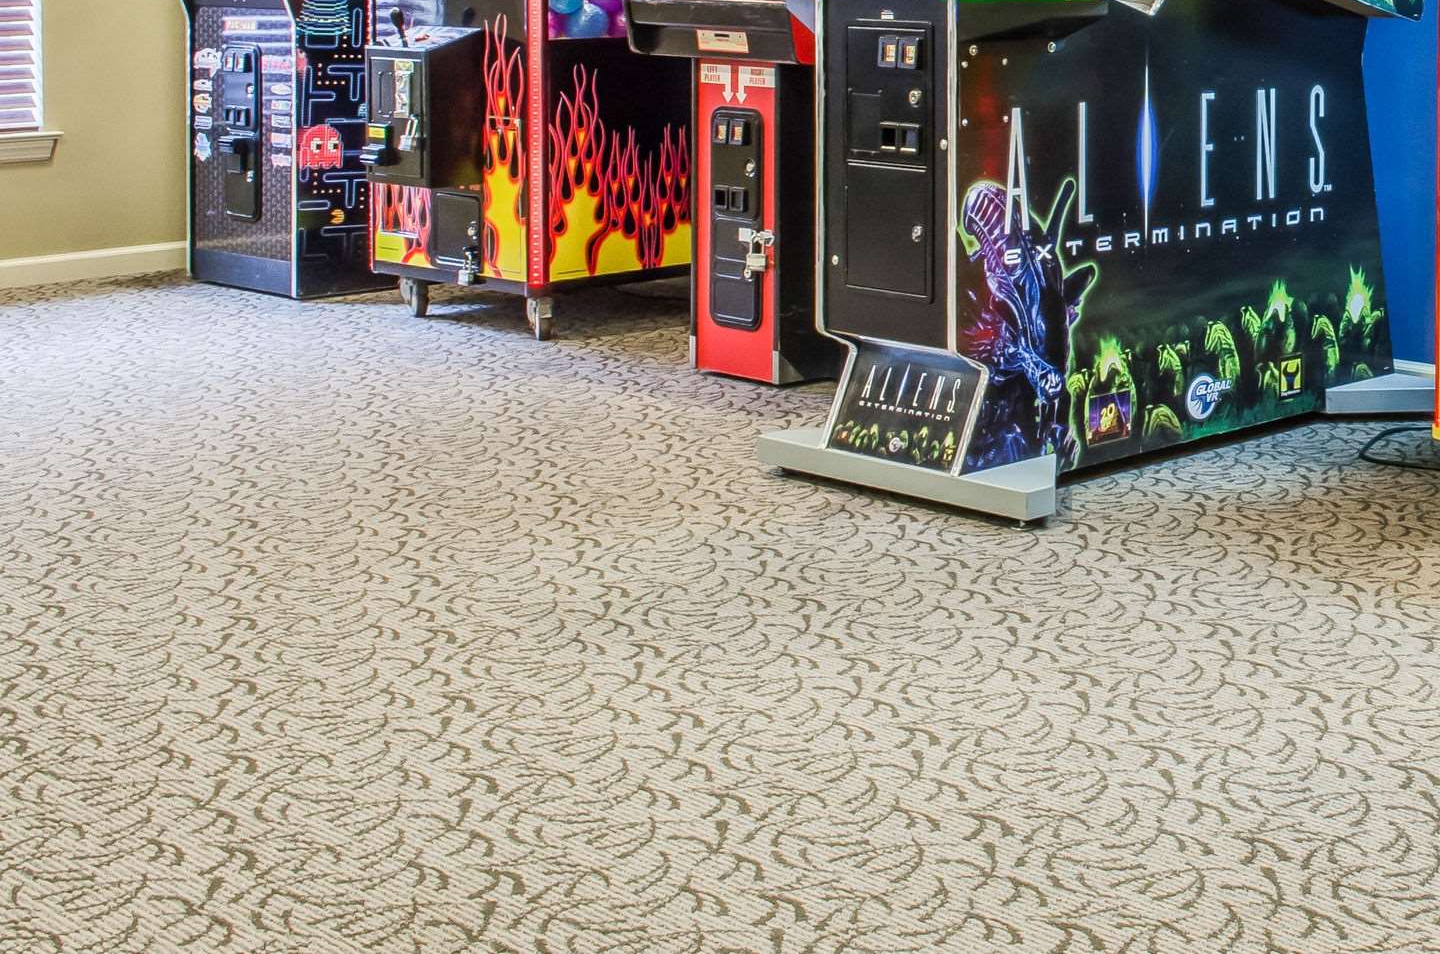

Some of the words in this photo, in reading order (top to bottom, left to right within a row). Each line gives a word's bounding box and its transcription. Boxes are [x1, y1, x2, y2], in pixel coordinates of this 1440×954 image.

[1004, 76, 1326, 236] ALIENS
[1004, 207, 1325, 265] EXTERMINATION
[860, 362, 962, 415] ALIENS
[1196, 379, 1231, 396] GLOBAL
[1206, 392, 1220, 404] VR
[858, 400, 951, 422] EXTERMINATION
